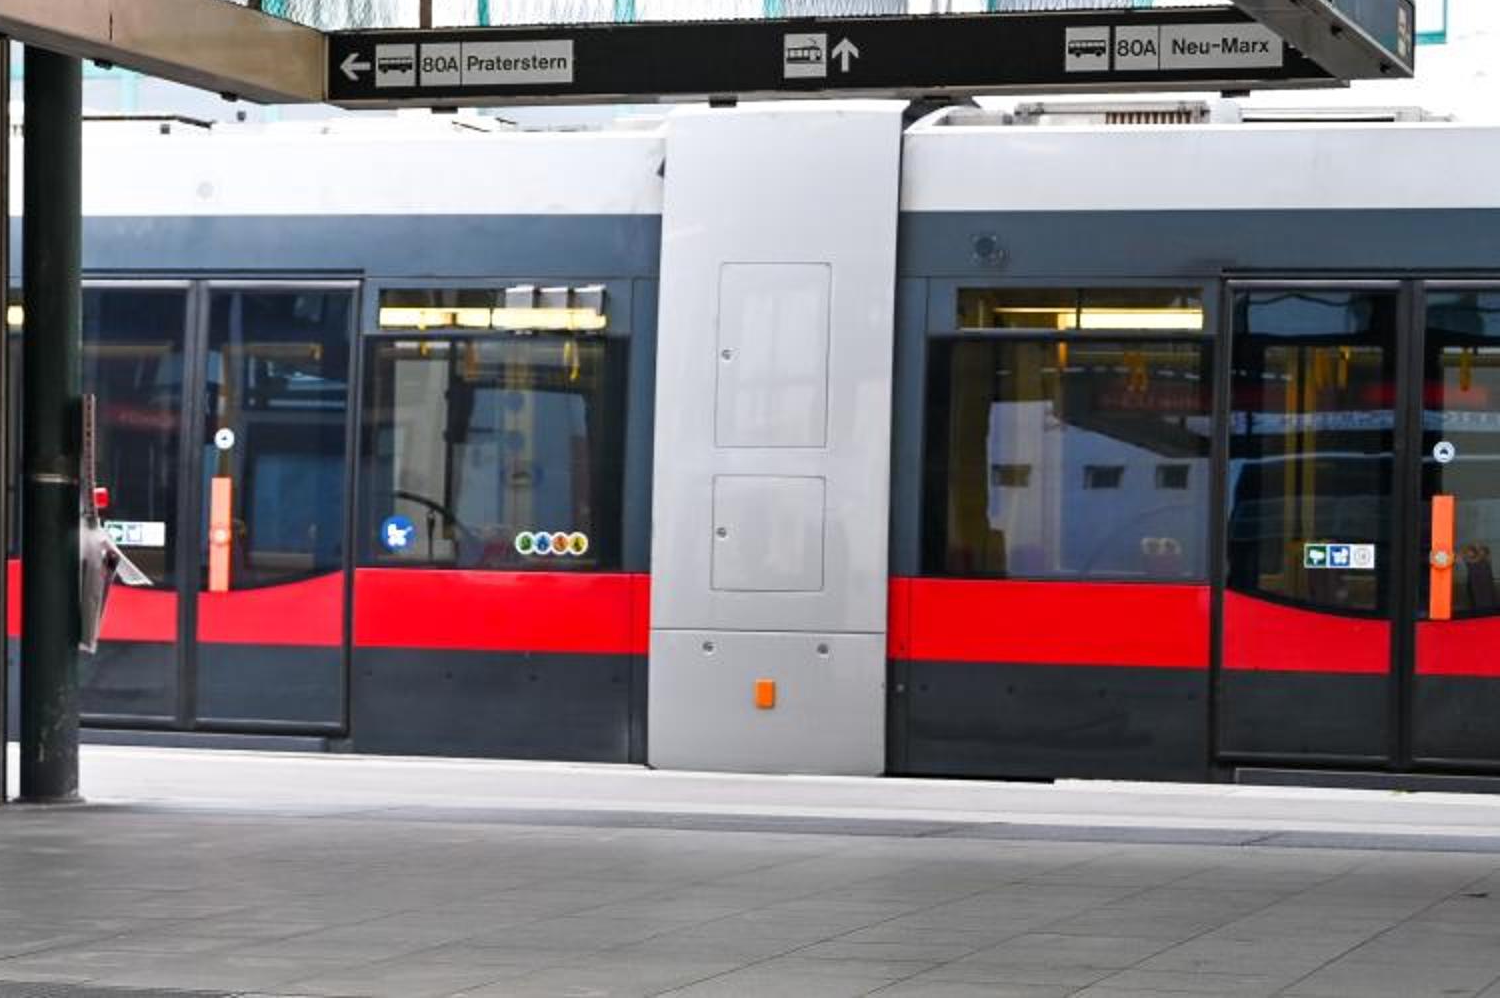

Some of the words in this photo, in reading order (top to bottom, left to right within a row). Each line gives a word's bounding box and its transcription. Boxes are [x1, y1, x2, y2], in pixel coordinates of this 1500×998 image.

[1117, 39, 1157, 57] 80A
[1171, 37, 1270, 56] Neu-Marx
[421, 58, 459, 74] 80A
[466, 53, 568, 73] Praterstern
